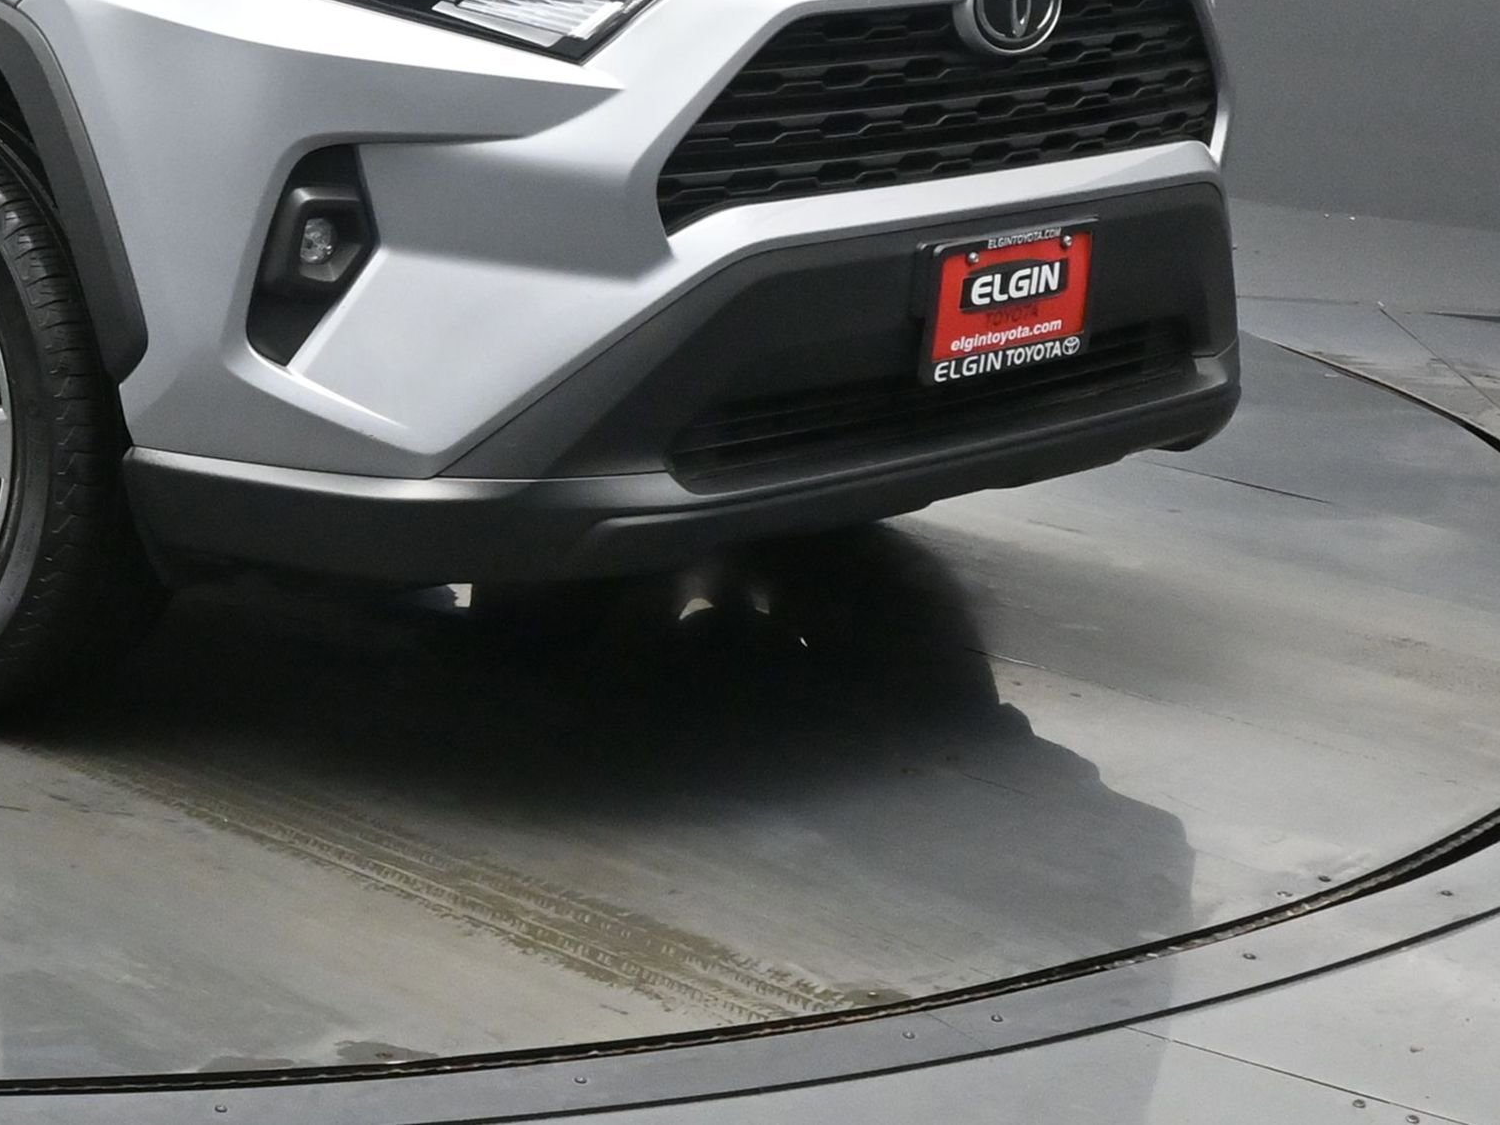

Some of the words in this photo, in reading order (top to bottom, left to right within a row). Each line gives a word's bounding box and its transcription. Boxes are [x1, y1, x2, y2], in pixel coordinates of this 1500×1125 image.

[988, 228, 1062, 249] ELGINTOYOTA.COM
[971, 262, 1060, 305] ELGIN
[950, 319, 1062, 352] elgintoyota.com
[934, 351, 1002, 382] ELGIN
[1006, 341, 1062, 366] TOYOTA
